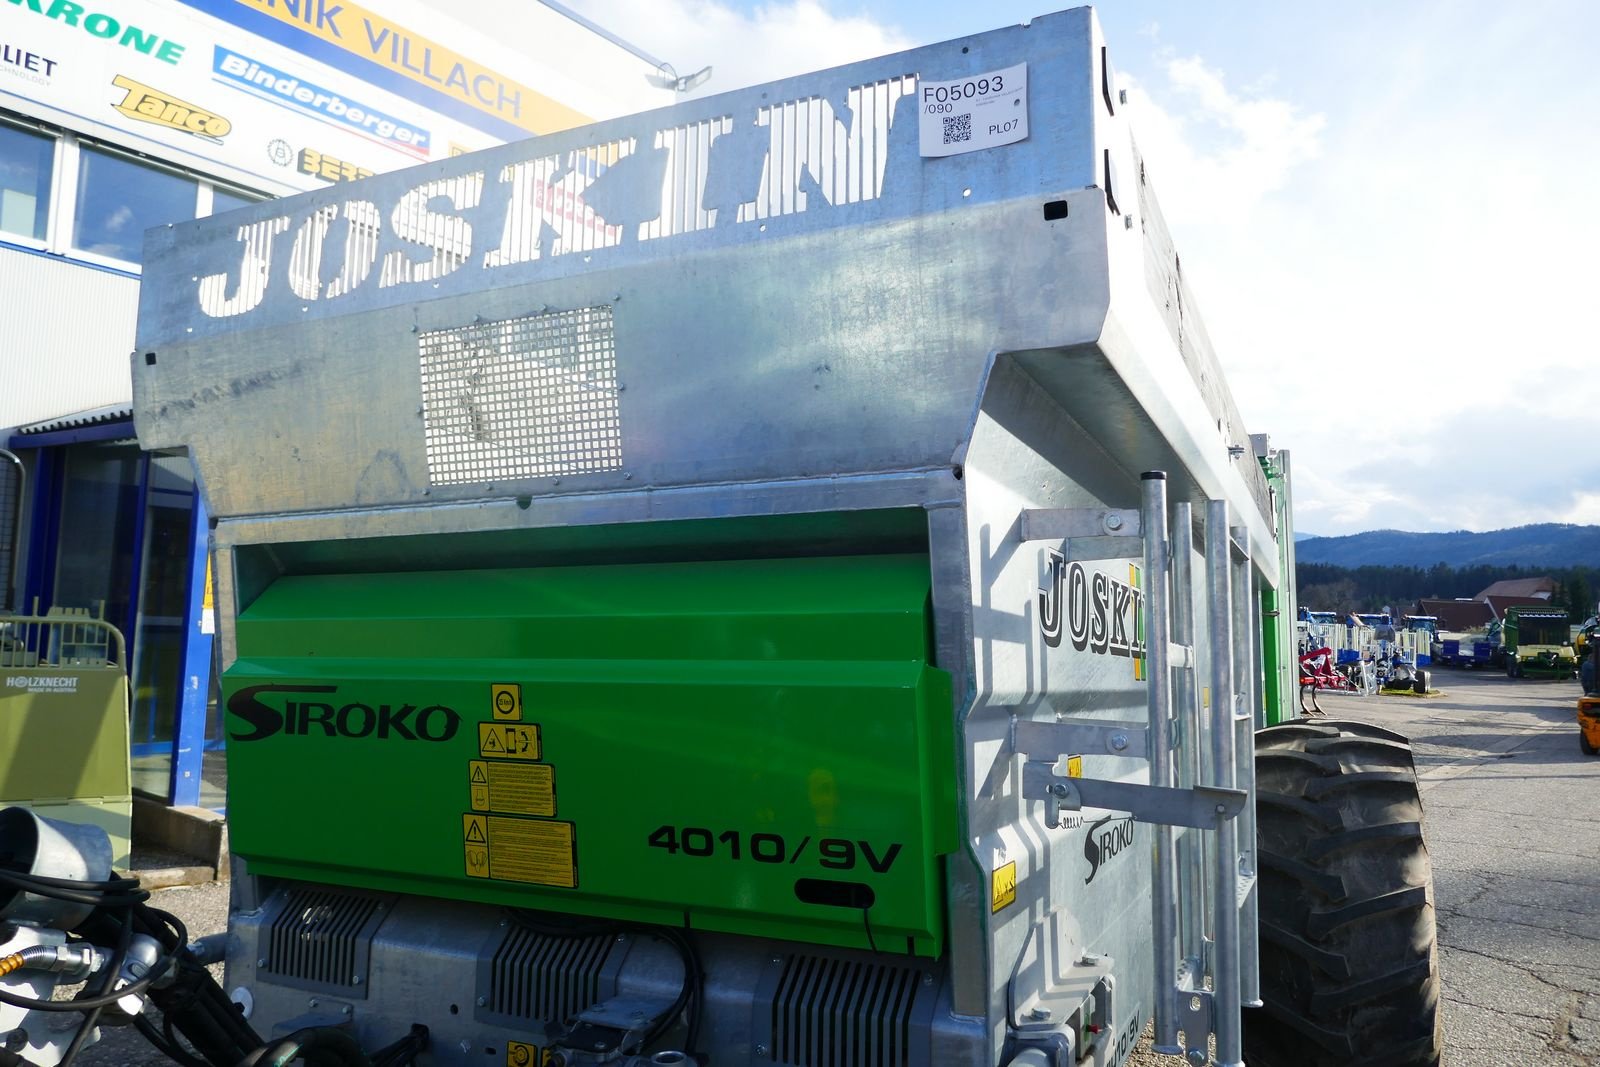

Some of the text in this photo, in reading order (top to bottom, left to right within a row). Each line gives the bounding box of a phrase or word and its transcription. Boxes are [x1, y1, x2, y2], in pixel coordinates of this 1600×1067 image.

[0, 44, 58, 77] LIET
[362, 18, 521, 118] VILLACH
[110, 74, 232, 138] Tanco
[220, 53, 427, 146] Binderberger
[924, 103, 953, 114] /090
[989, 118, 1018, 135] PL07
[198, 73, 920, 317] JOSKIN
[1038, 547, 1146, 660] JOSKI
[6, 676, 78, 687] HOLZKNECHT
[227, 684, 462, 742] SIROKO
[648, 825, 903, 873] 4010/9V
[1084, 815, 1134, 885] SIROKO
